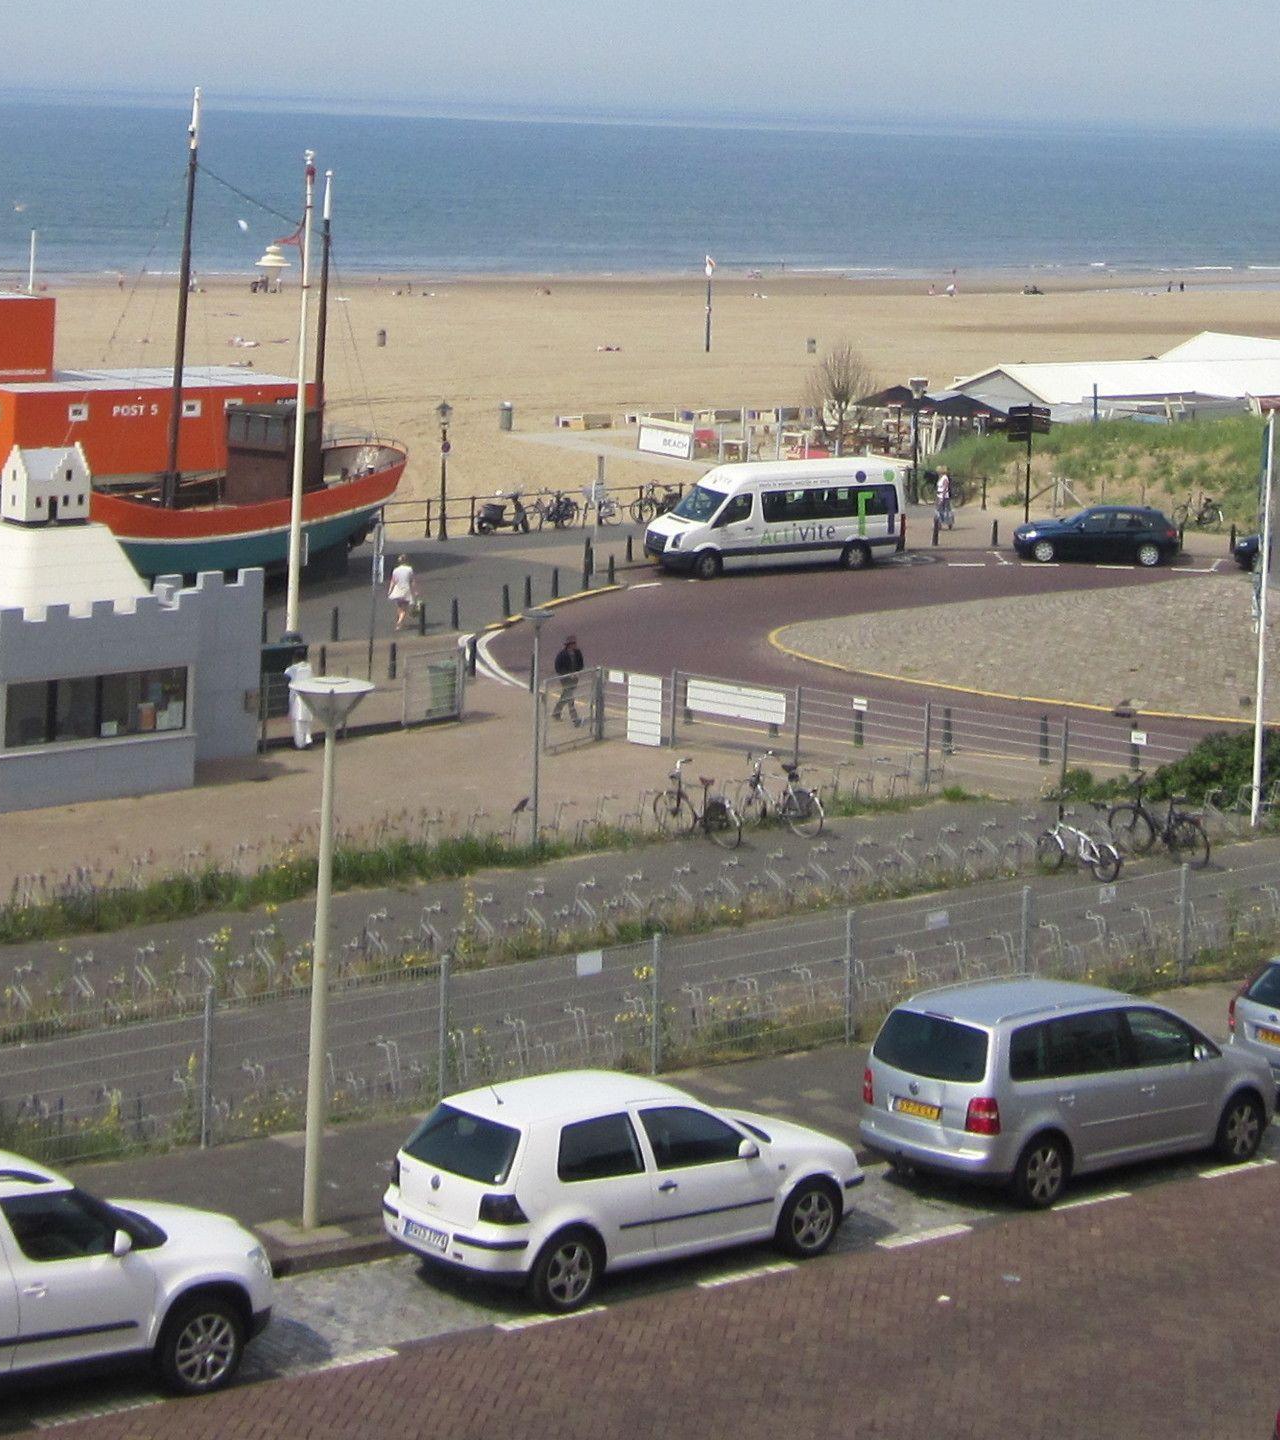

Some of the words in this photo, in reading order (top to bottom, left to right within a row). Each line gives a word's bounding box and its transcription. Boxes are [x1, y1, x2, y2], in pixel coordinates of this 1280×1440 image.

[112, 404, 145, 417] POST
[150, 404, 159, 416] 5
[662, 438, 688, 449] BEACH
